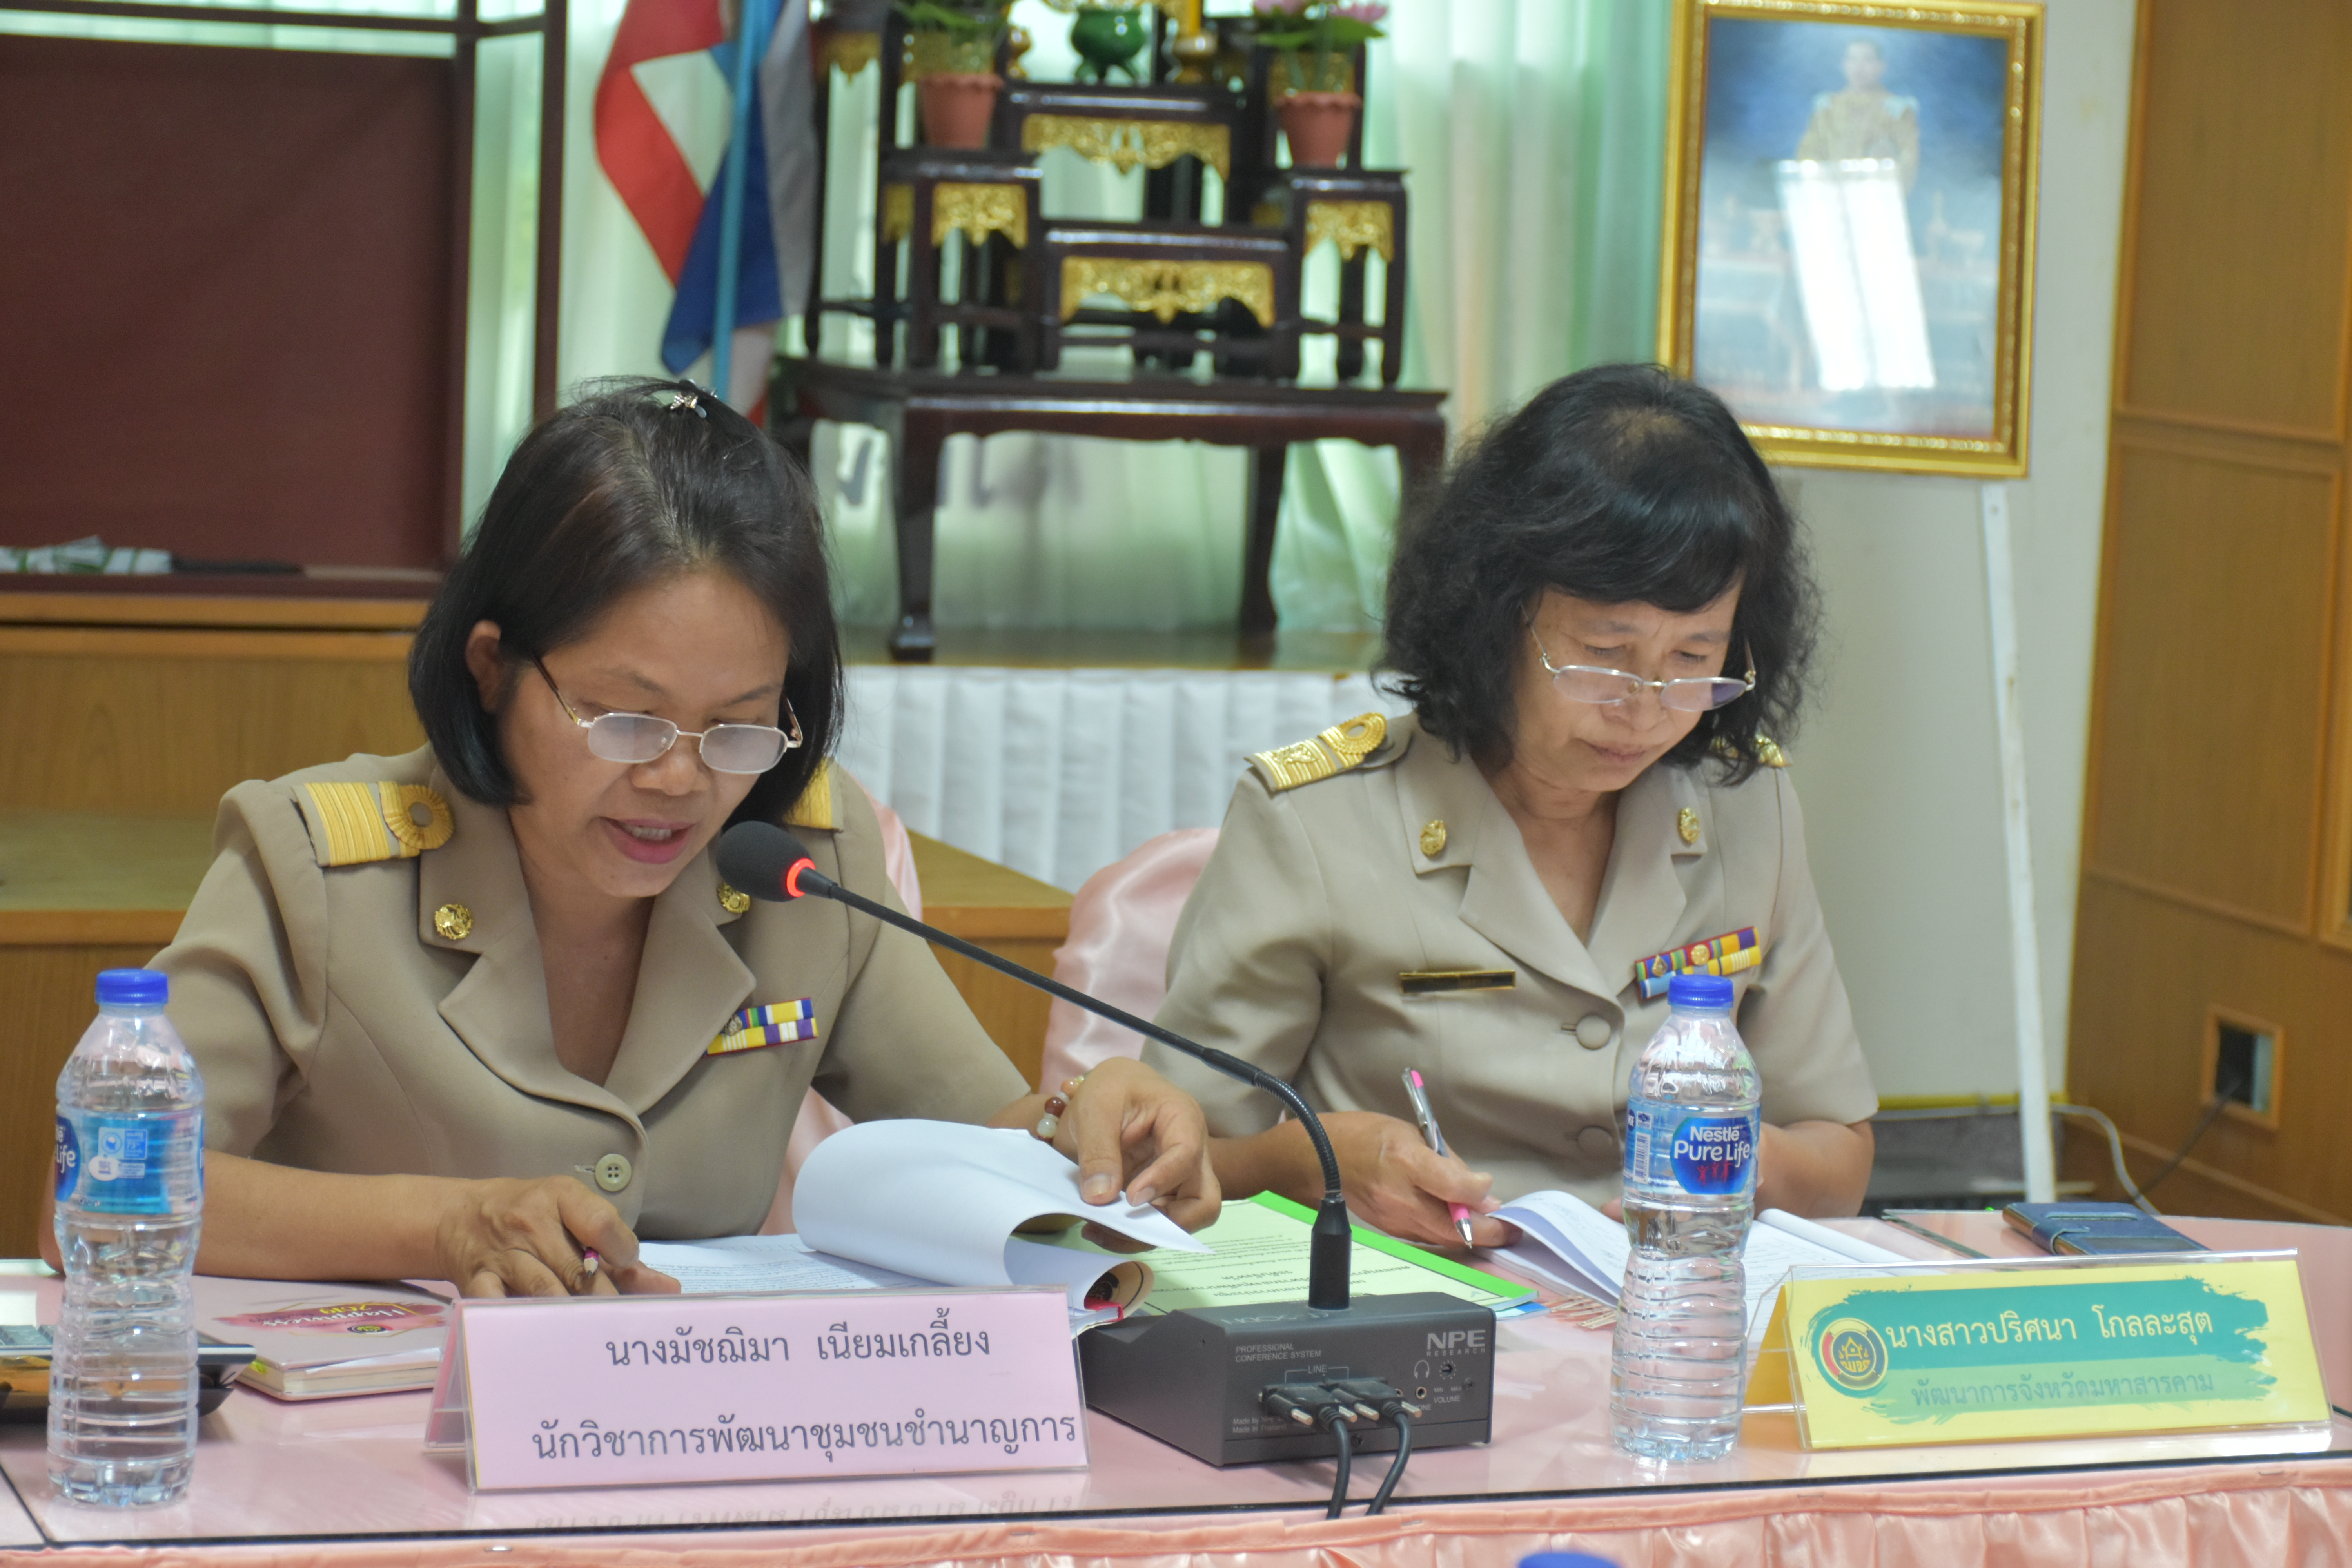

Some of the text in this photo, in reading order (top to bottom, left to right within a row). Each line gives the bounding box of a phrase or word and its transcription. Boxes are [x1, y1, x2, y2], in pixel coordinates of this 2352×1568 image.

[1690, 1126, 1740, 1142] Nestlé
[1674, 1140, 1723, 1161] Pure
[1726, 1141, 1750, 1167] Life
[1886, 1304, 2213, 1348] นางสาวปริศนา โกลละสุต
[606, 1307, 990, 1366] นางมัชฌิมา เนียมเกลี้ยง
[1427, 1330, 1486, 1350] NPE
[1236, 1343, 1294, 1353] PROFESSIONAL
[1236, 1350, 1321, 1363] CONFERENCE SYSTEM
[1426, 1348, 1486, 1357] RESEARCH
[1308, 1365, 1327, 1374] LINE
[1911, 1372, 2214, 1406] พัฒนาการจังหวัดมหาสารคาม
[532, 1408, 1076, 1463] นักวิชาการพัฒนาชุมชนชำนาญการ
